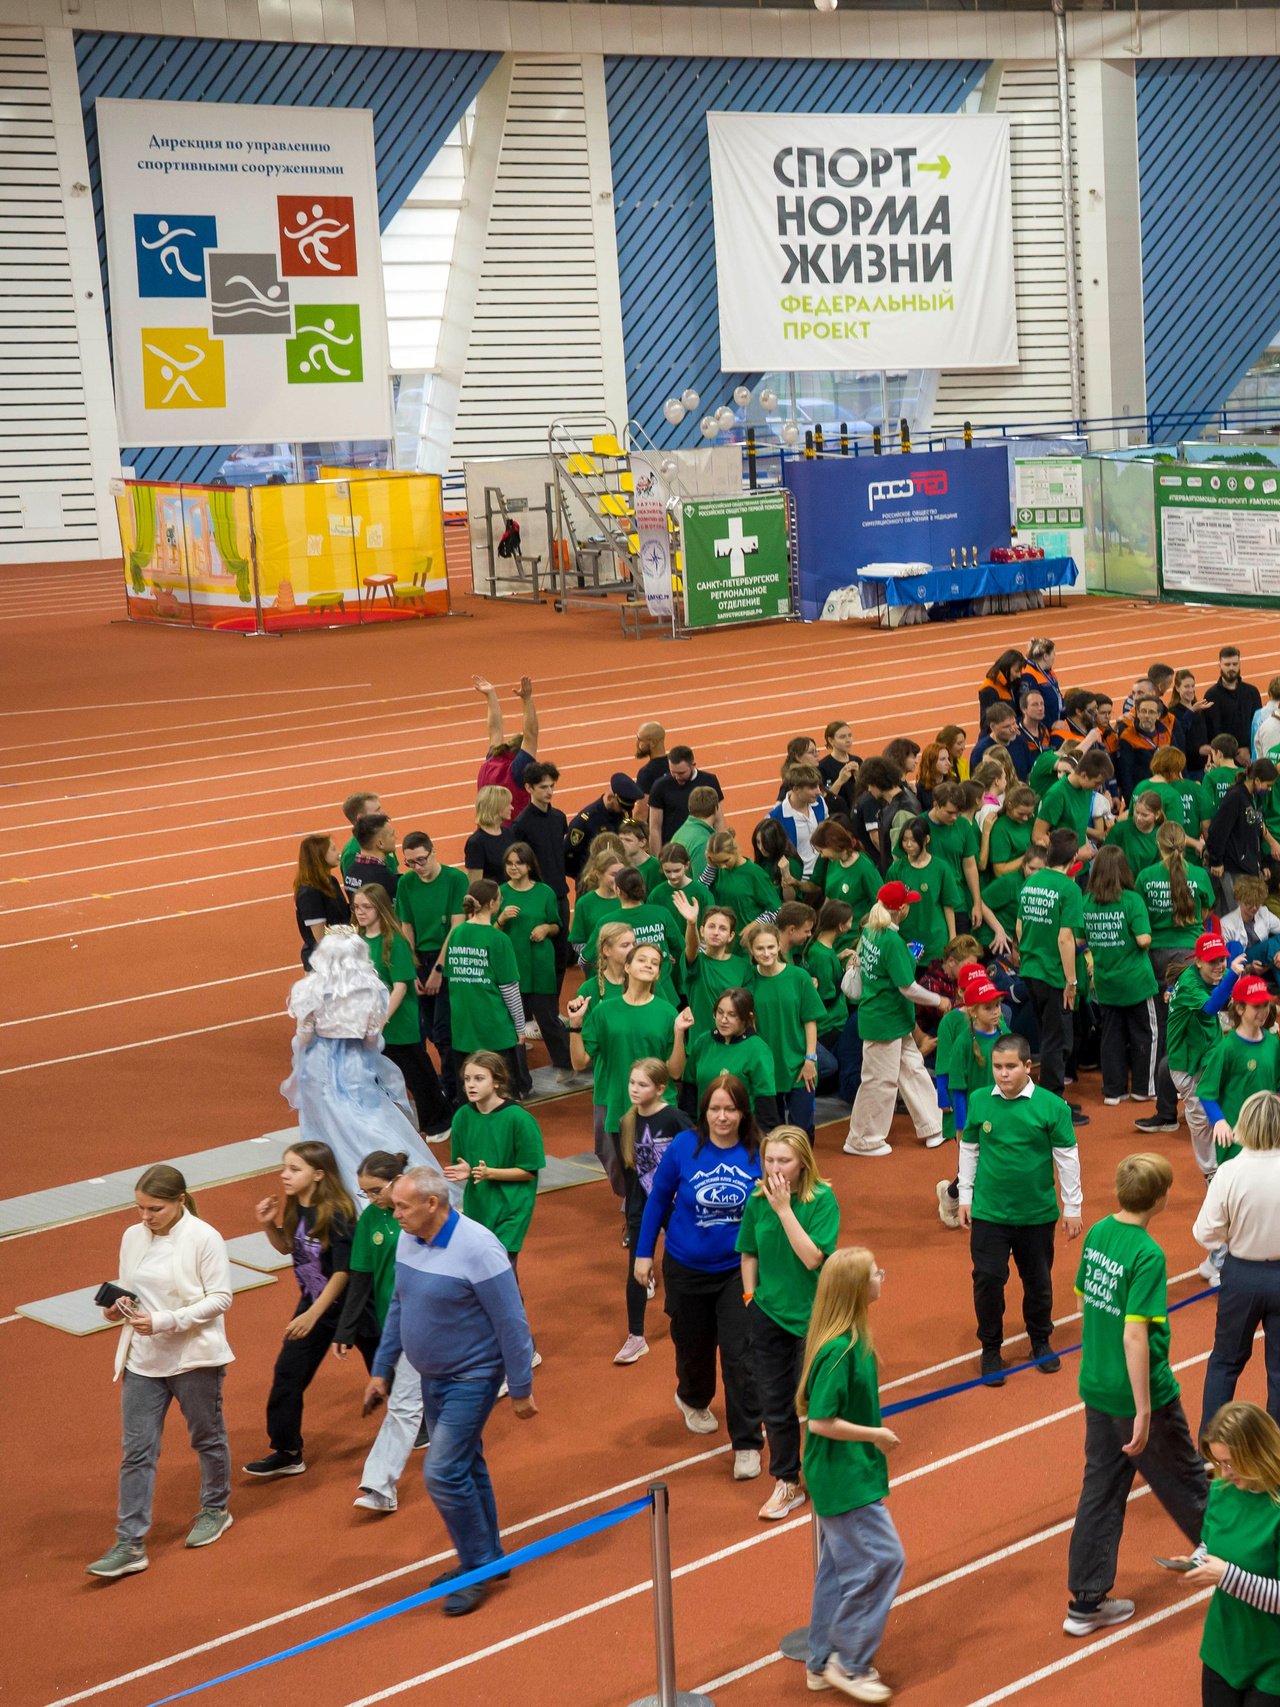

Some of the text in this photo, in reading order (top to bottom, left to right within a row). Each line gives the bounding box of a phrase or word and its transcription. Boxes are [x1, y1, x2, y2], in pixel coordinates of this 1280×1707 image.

[149, 134, 331, 155] Дирекция по управлению
[137, 159, 345, 177] спортивными сооружениями
[773, 147, 917, 188] СПОРТ
[777, 195, 951, 236] НОРМА
[780, 242, 954, 284] ЖИЗНИ
[780, 289, 954, 316] ФЕДЕРАЛЬНЫЙ
[783, 321, 871, 340] ПРОЕКТ
[696, 573, 779, 590] САНКТ-ПЕТЕРБУРГСКОЕ
[711, 585, 767, 600] РЕГИОНАЛЬНОЕ
[718, 597, 760, 610] ОТДЕЛЕНИЕ
[717, 608, 763, 619] ЗАПУСТИСЕРДЦЕ.РФ
[1094, 920, 1123, 931] ПЕРВОЙ
[449, 957, 458, 965] ПО
